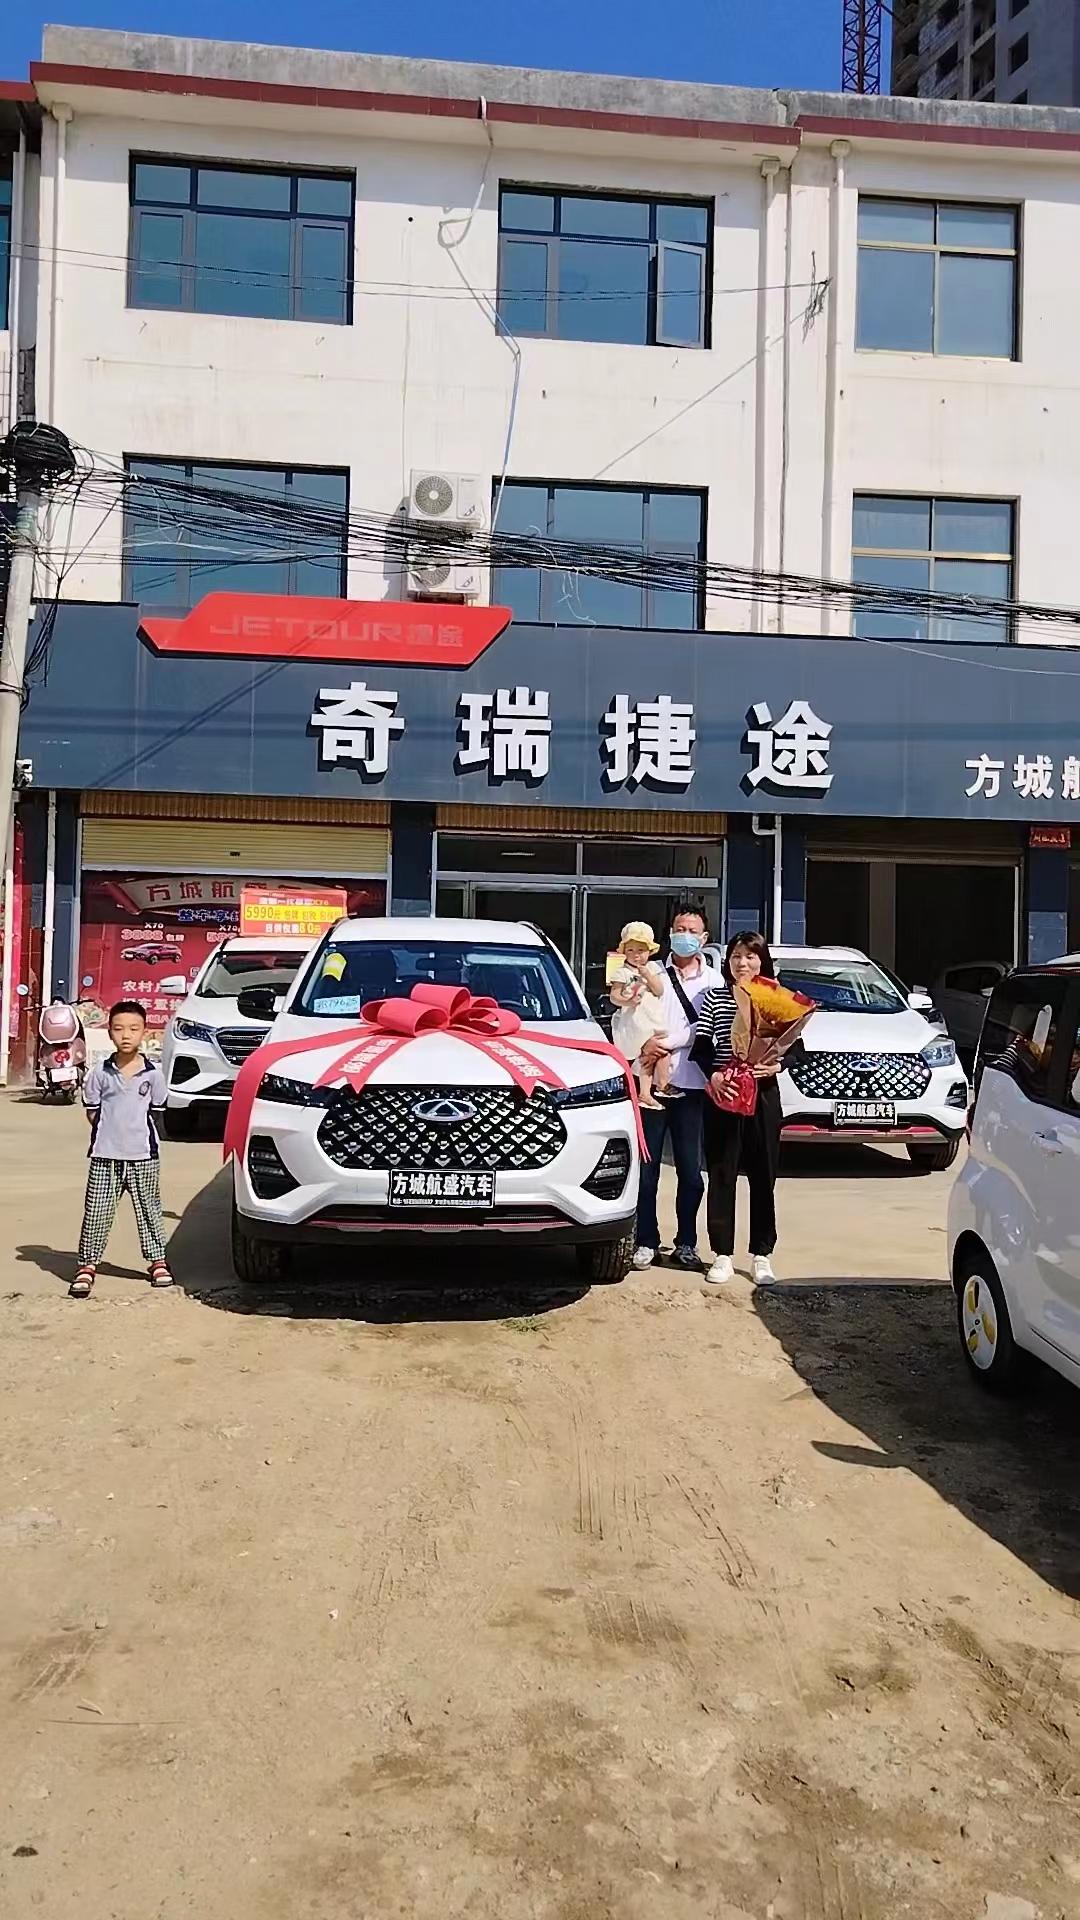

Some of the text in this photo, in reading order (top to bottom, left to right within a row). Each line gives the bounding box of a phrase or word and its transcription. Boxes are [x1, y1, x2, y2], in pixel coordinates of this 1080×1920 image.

[210, 615, 401, 643] JETOUR
[310, 681, 835, 789] 奇瑞捷途
[219, 924, 241, 932] X70
[838, 1103, 895, 1118] 方城航盛汽车
[393, 1172, 493, 1197] 方城航盛汽车
